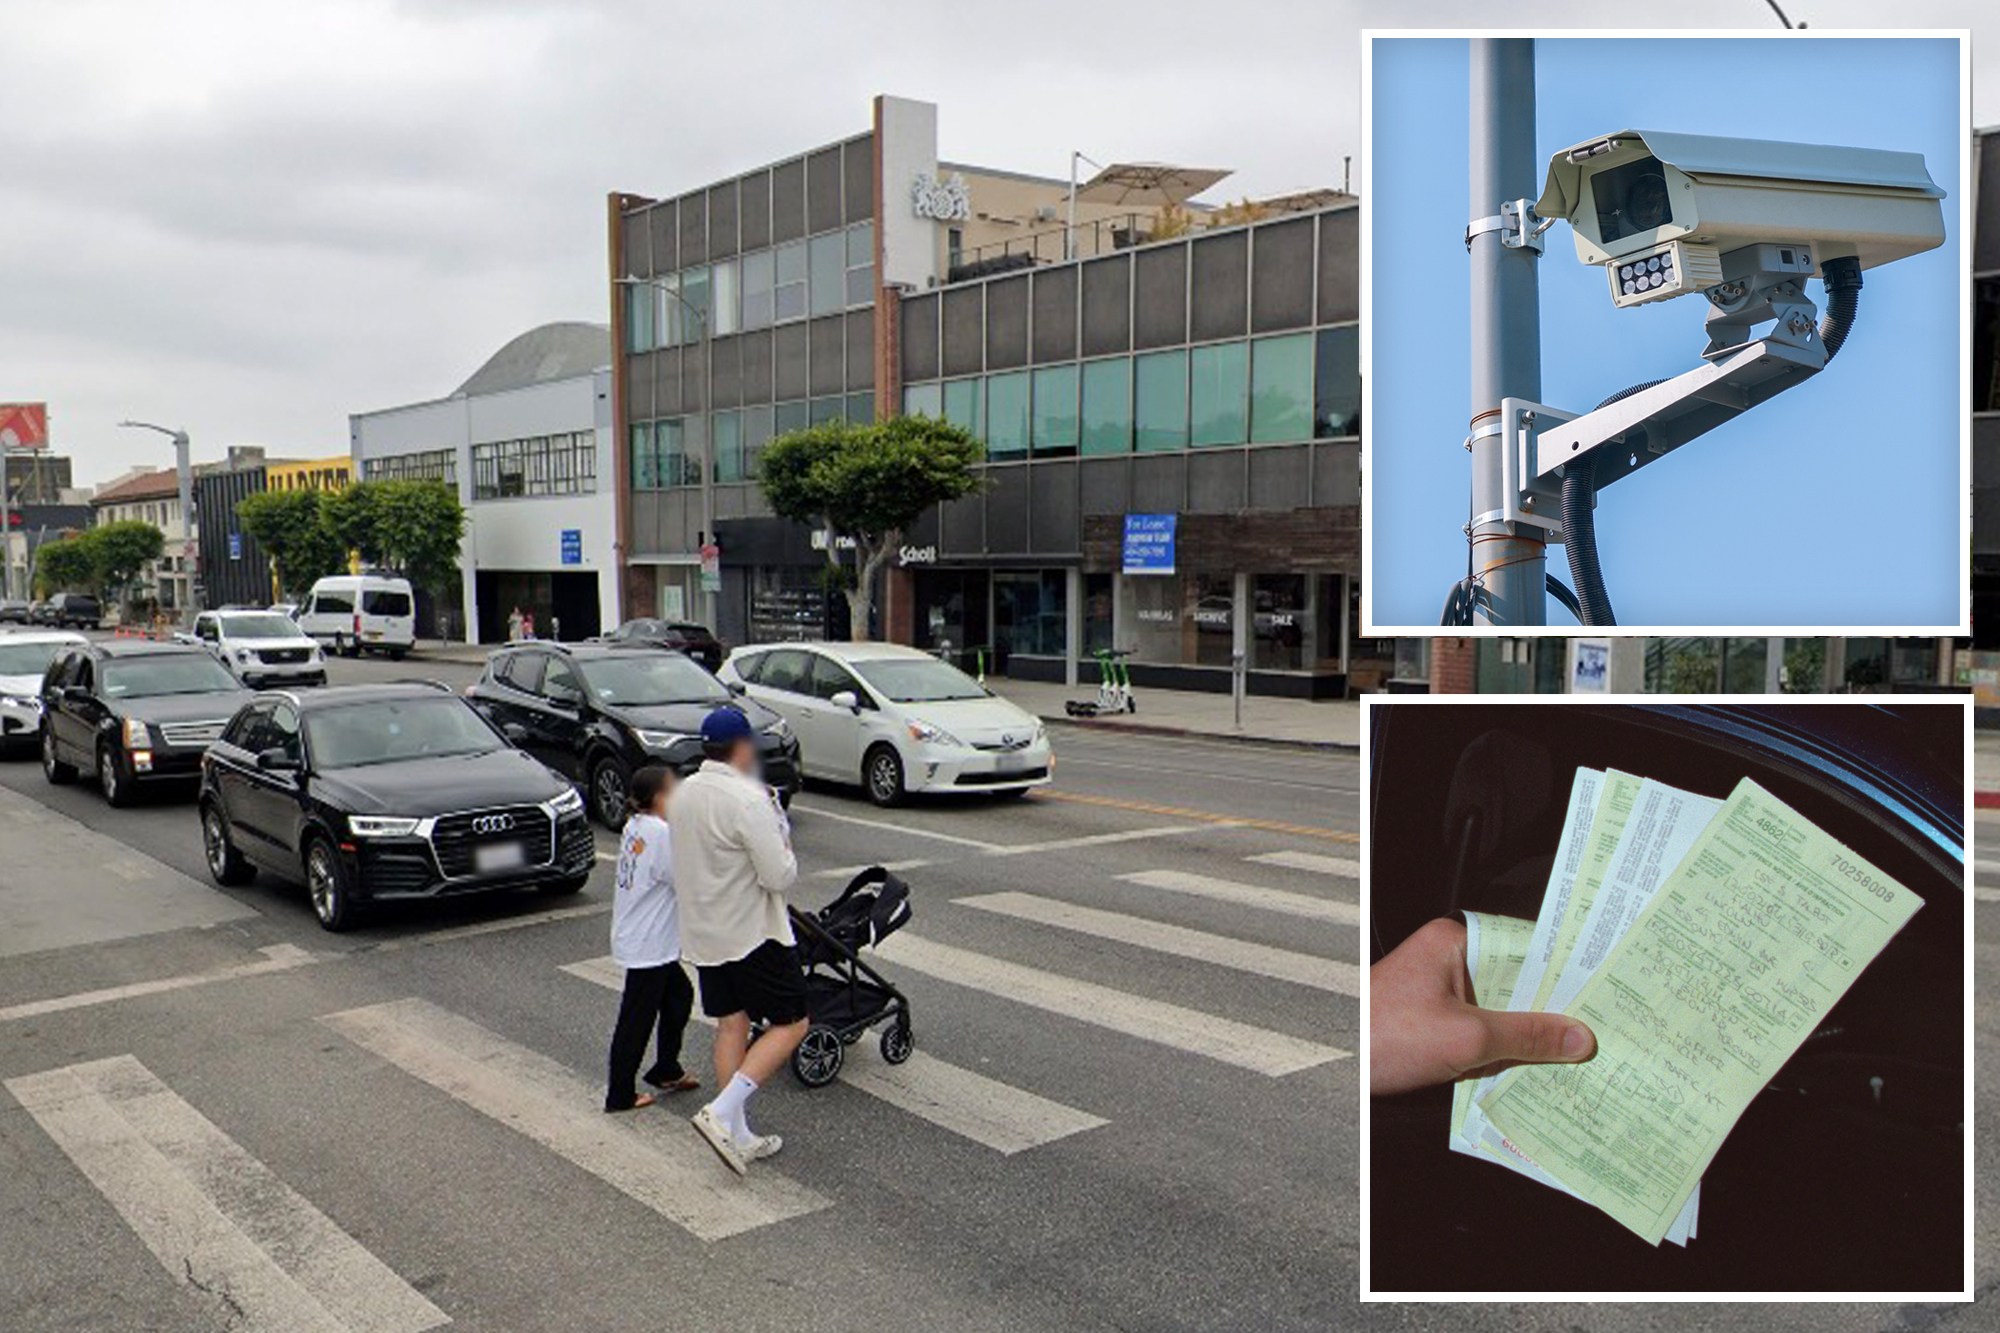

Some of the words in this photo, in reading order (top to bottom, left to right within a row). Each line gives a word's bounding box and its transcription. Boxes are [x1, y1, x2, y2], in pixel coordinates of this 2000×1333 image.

[1272, 615, 1293, 626] SALE
[1755, 818, 1785, 841] 4862
[1830, 854, 1896, 904] 70258008
